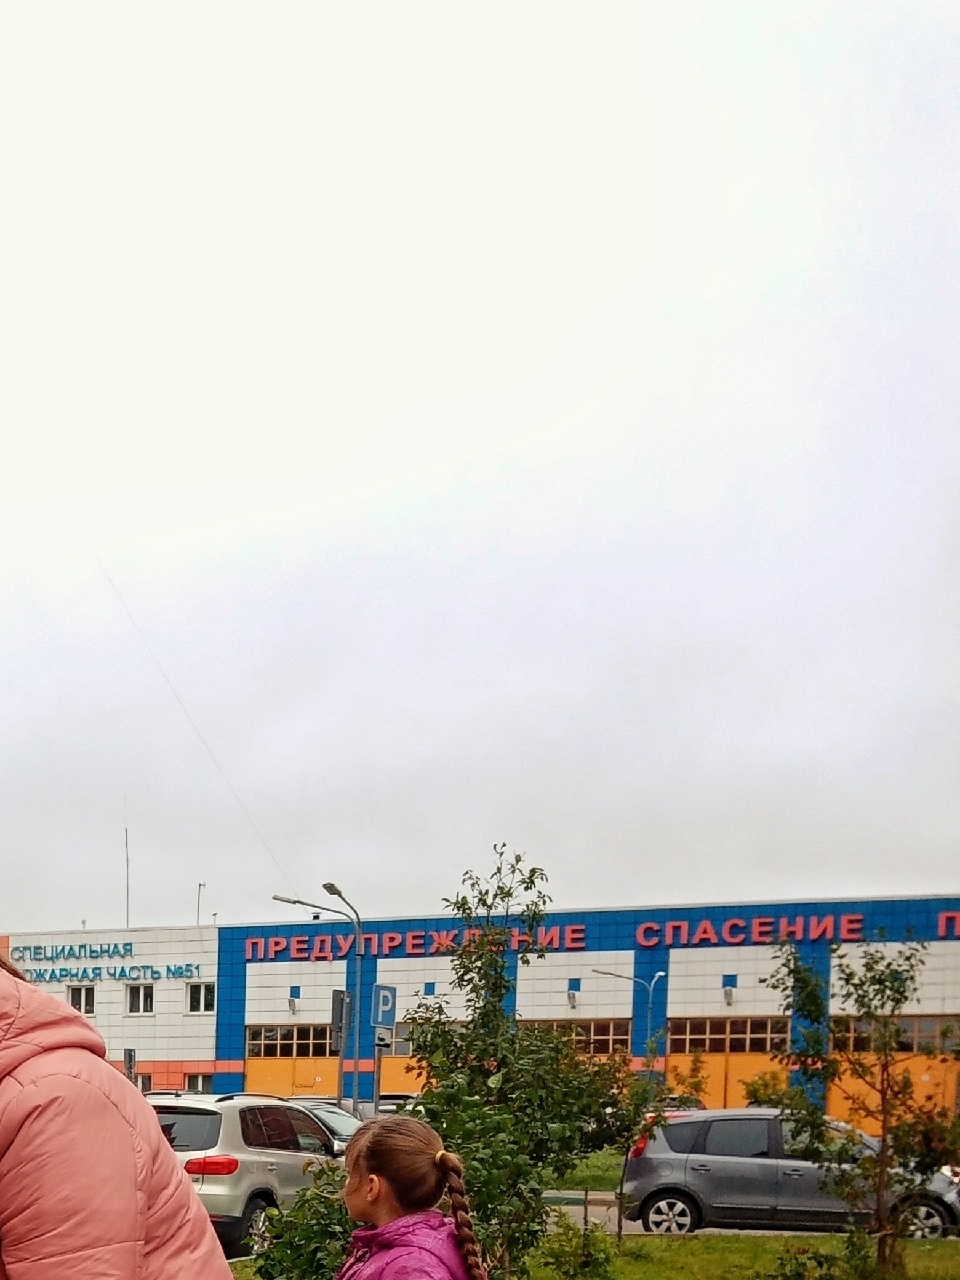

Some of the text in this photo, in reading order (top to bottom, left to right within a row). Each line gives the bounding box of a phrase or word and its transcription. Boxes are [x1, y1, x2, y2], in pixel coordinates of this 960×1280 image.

[635, 914, 864, 947] СПАСЕНИЕ
[11, 942, 133, 963] СПЕЦИАЛЬНАЯ
[22, 963, 200, 983] ОЖАРНАЯ ЧАСТЬ №51
